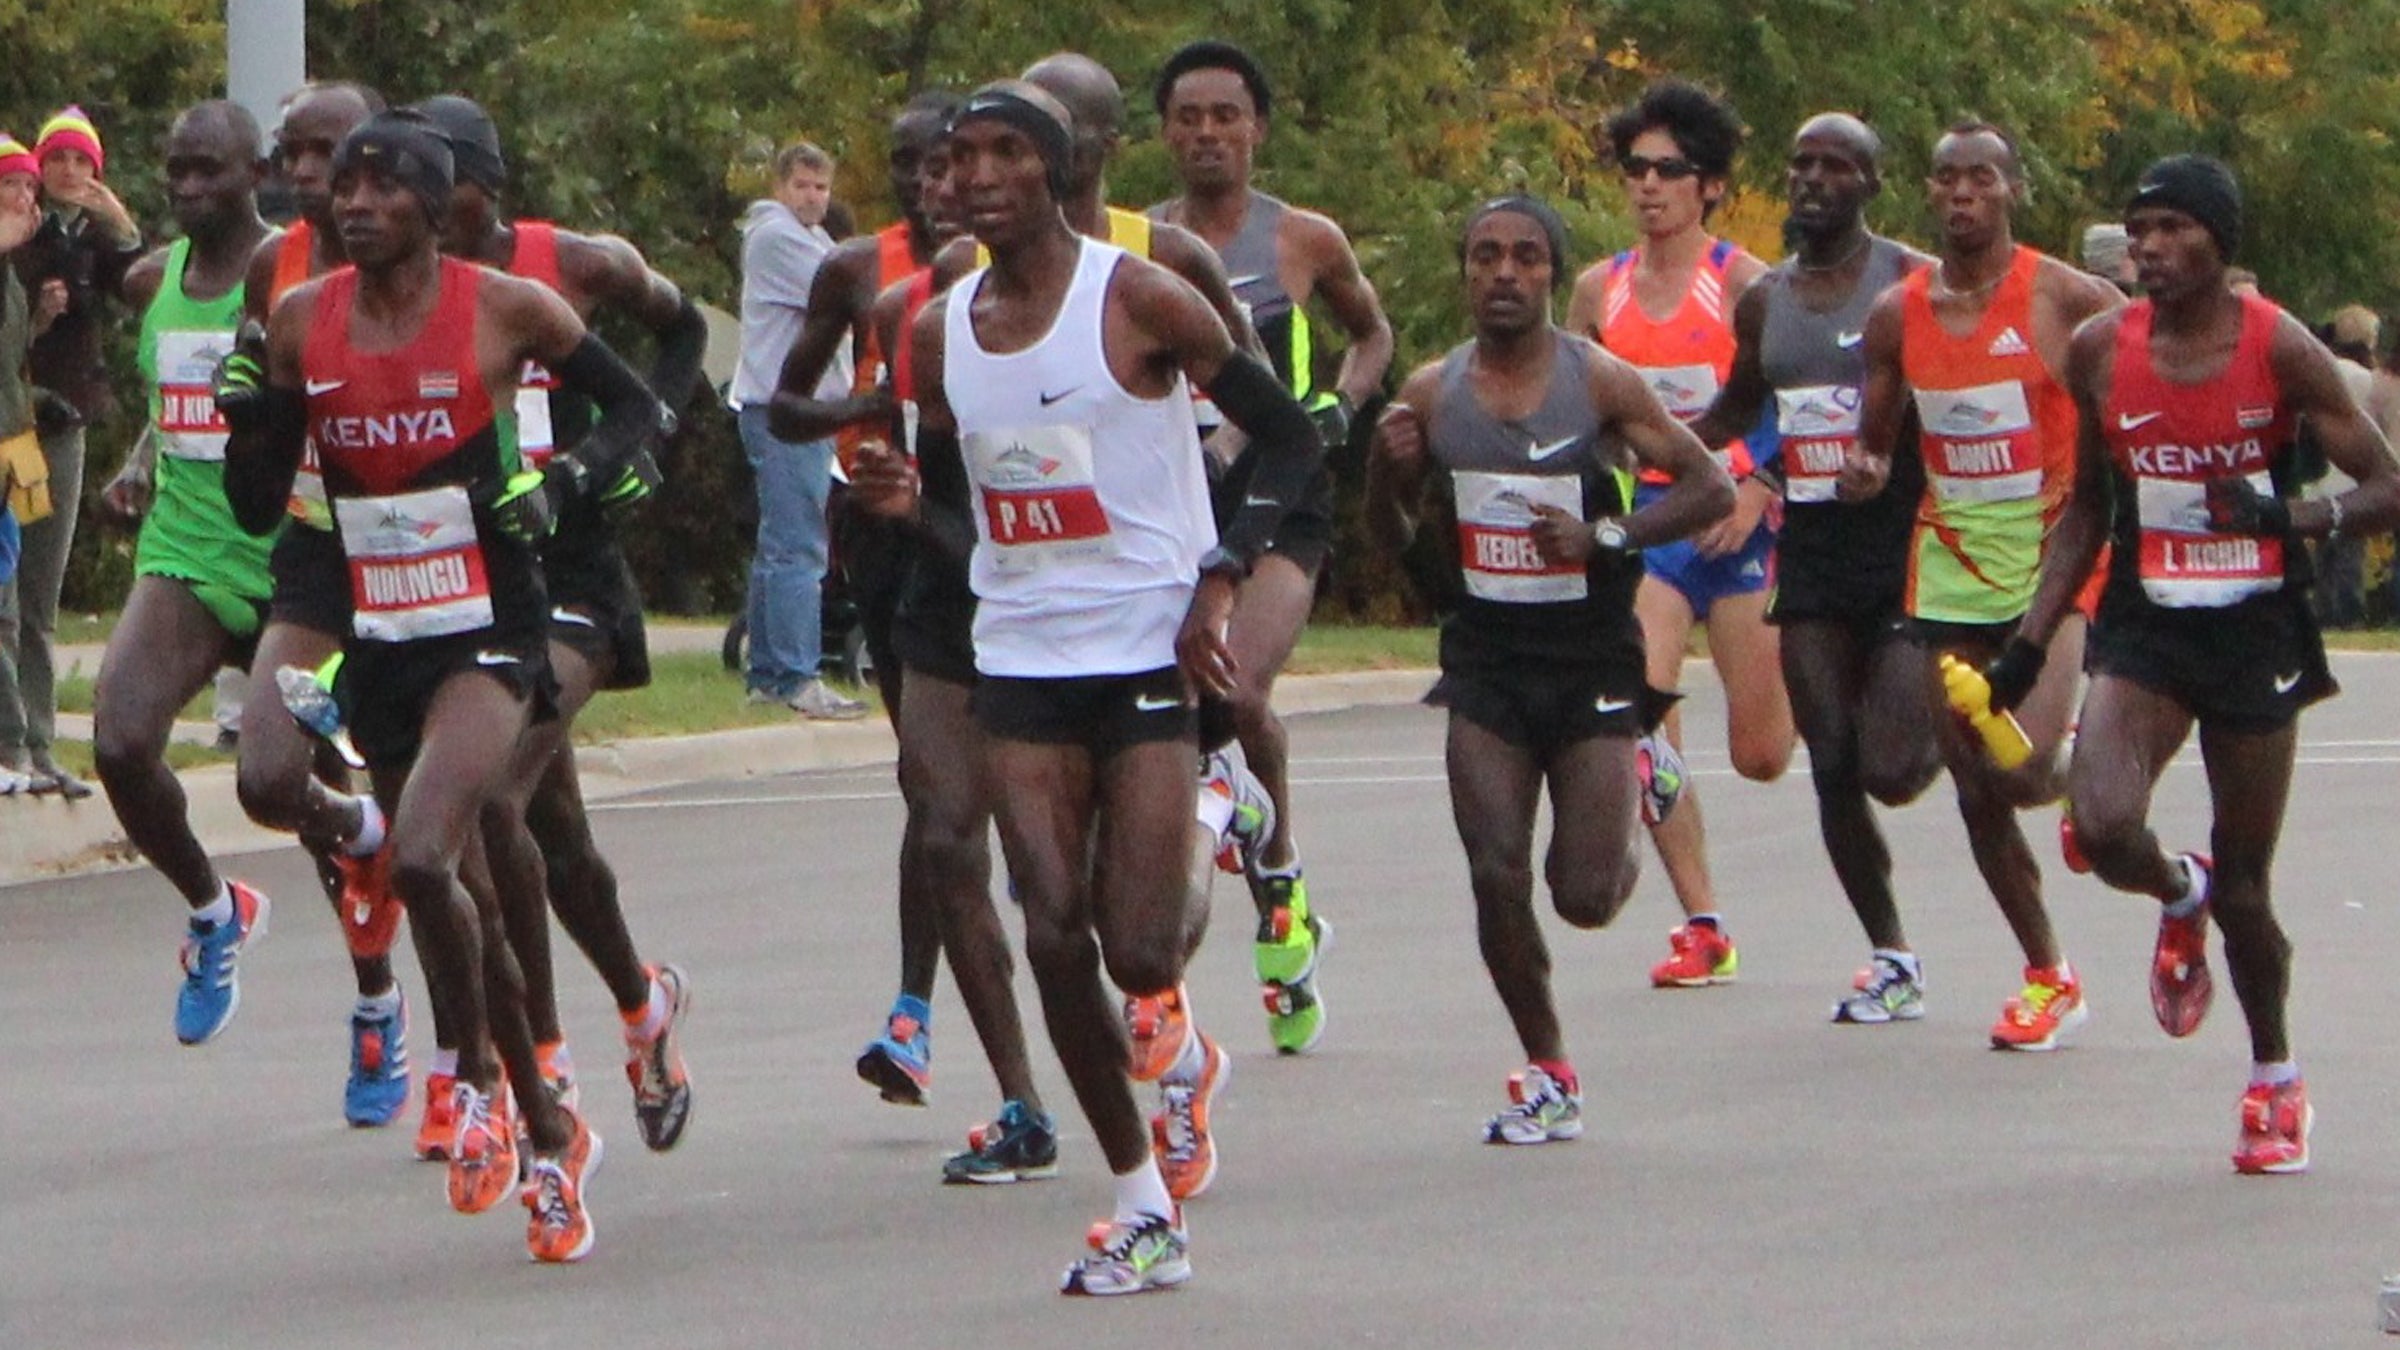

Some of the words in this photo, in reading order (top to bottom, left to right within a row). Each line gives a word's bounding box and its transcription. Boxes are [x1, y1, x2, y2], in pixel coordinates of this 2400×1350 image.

[320, 408, 455, 447] KENYA
[2128, 438, 2262, 473] KENYA
[999, 501, 1017, 539] P
[1026, 498, 1063, 535] 41
[1474, 532, 1547, 570] KEBE
[2163, 539, 2179, 572] L
[362, 553, 469, 606] NDUNGU
